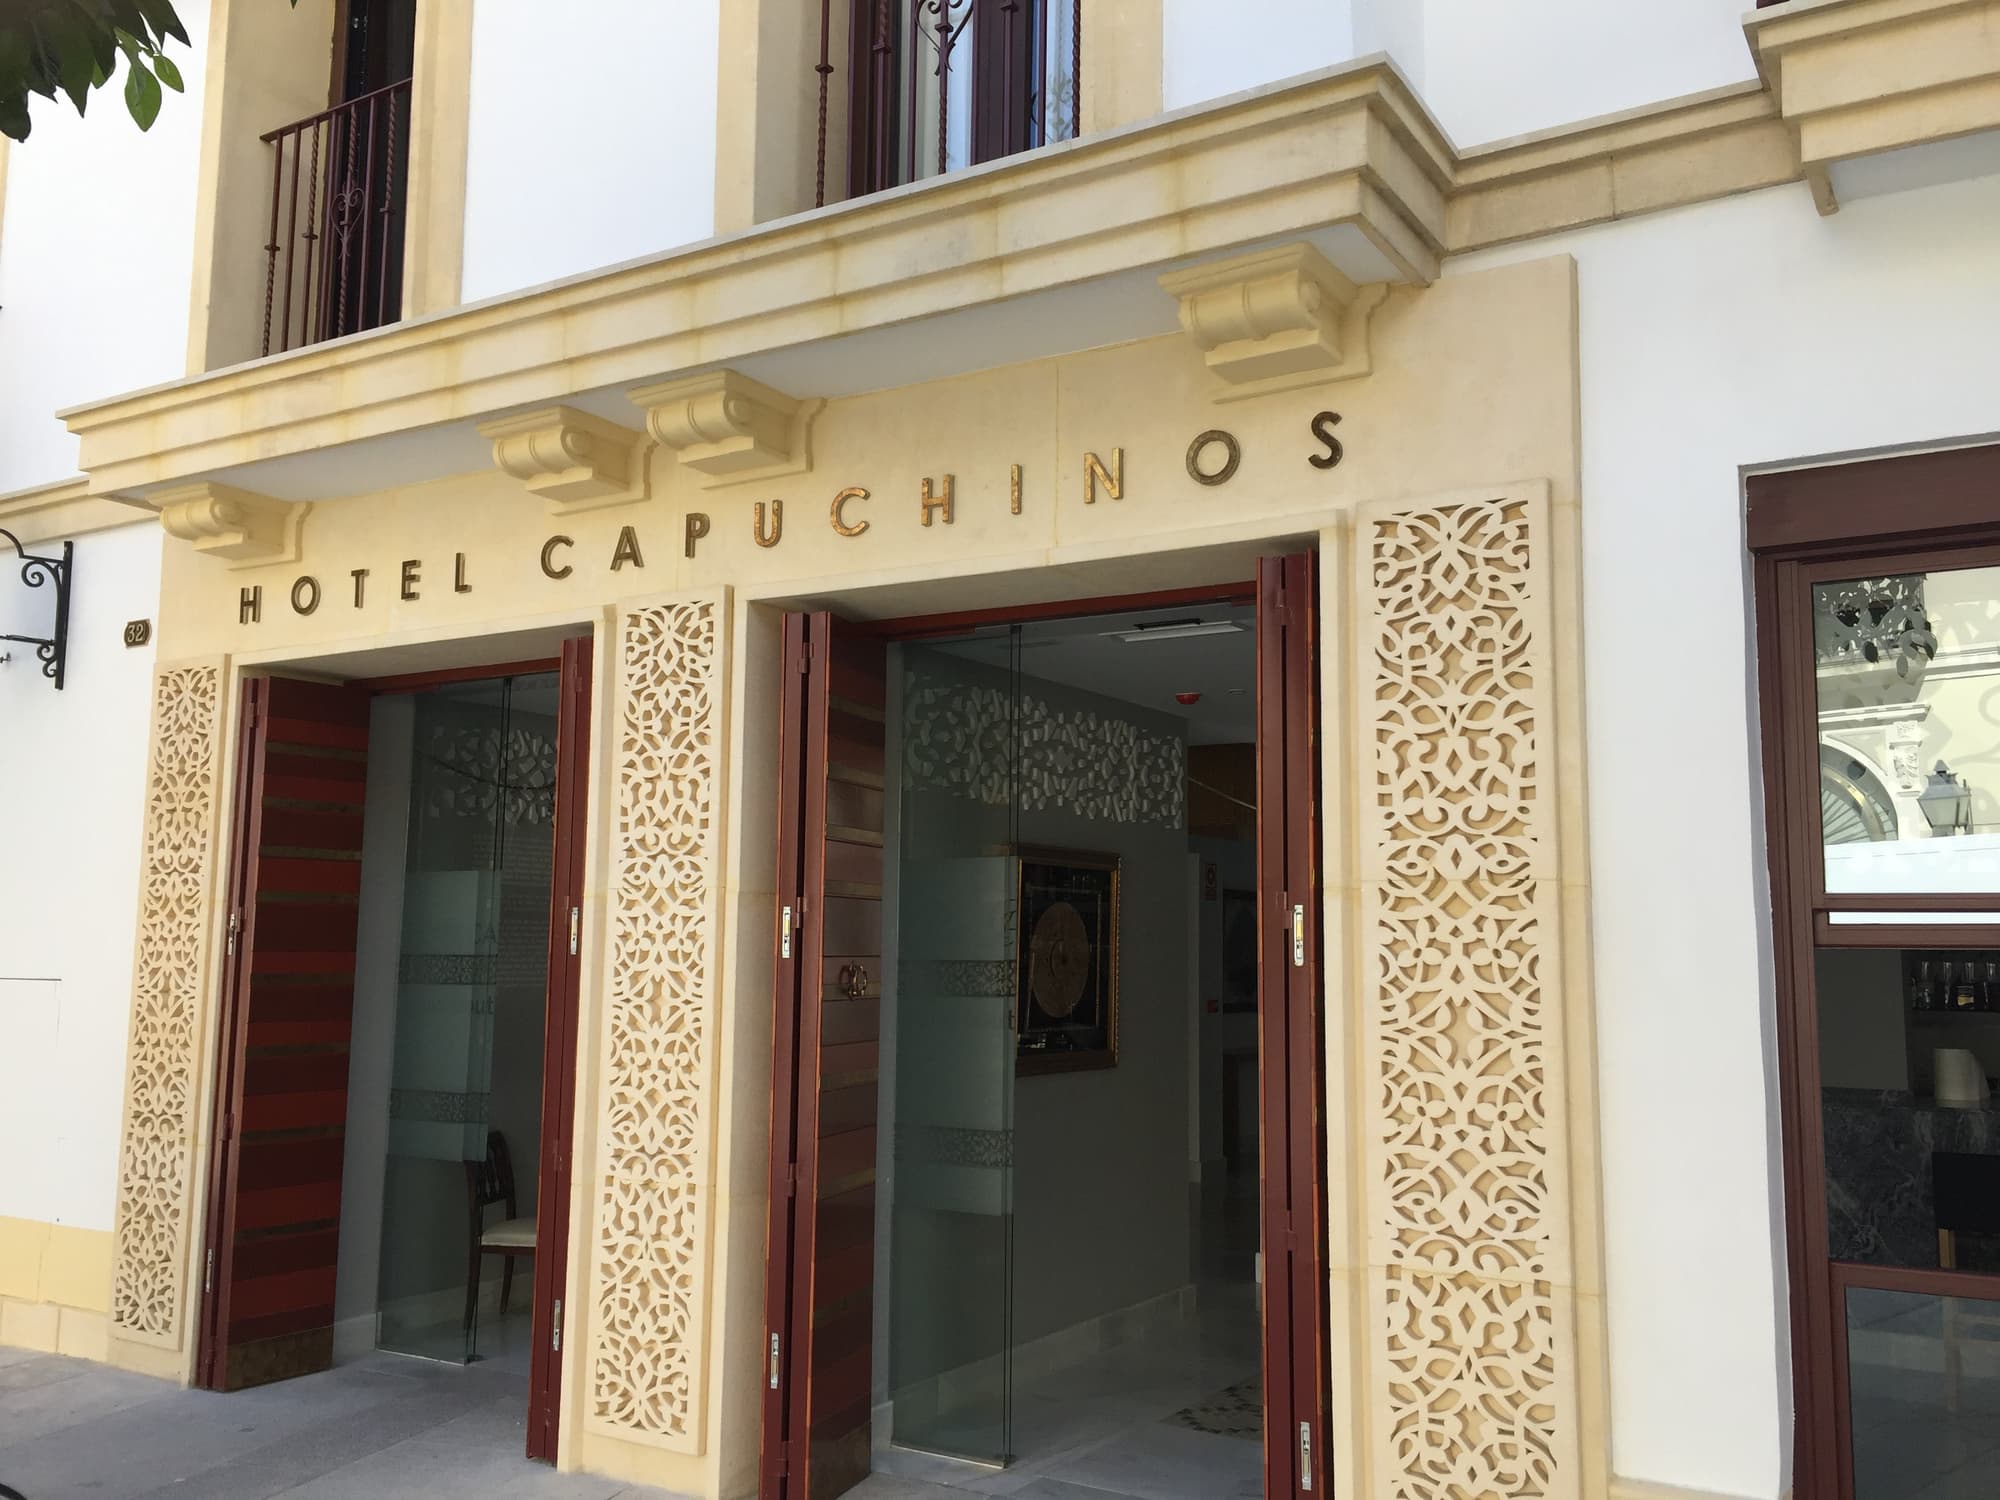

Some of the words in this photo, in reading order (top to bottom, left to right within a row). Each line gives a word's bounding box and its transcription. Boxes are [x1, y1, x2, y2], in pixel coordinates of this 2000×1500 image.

[239, 551, 472, 624] HOTEL
[540, 411, 1343, 580] CAPUCHINOS
[127, 623, 144, 643] 32
